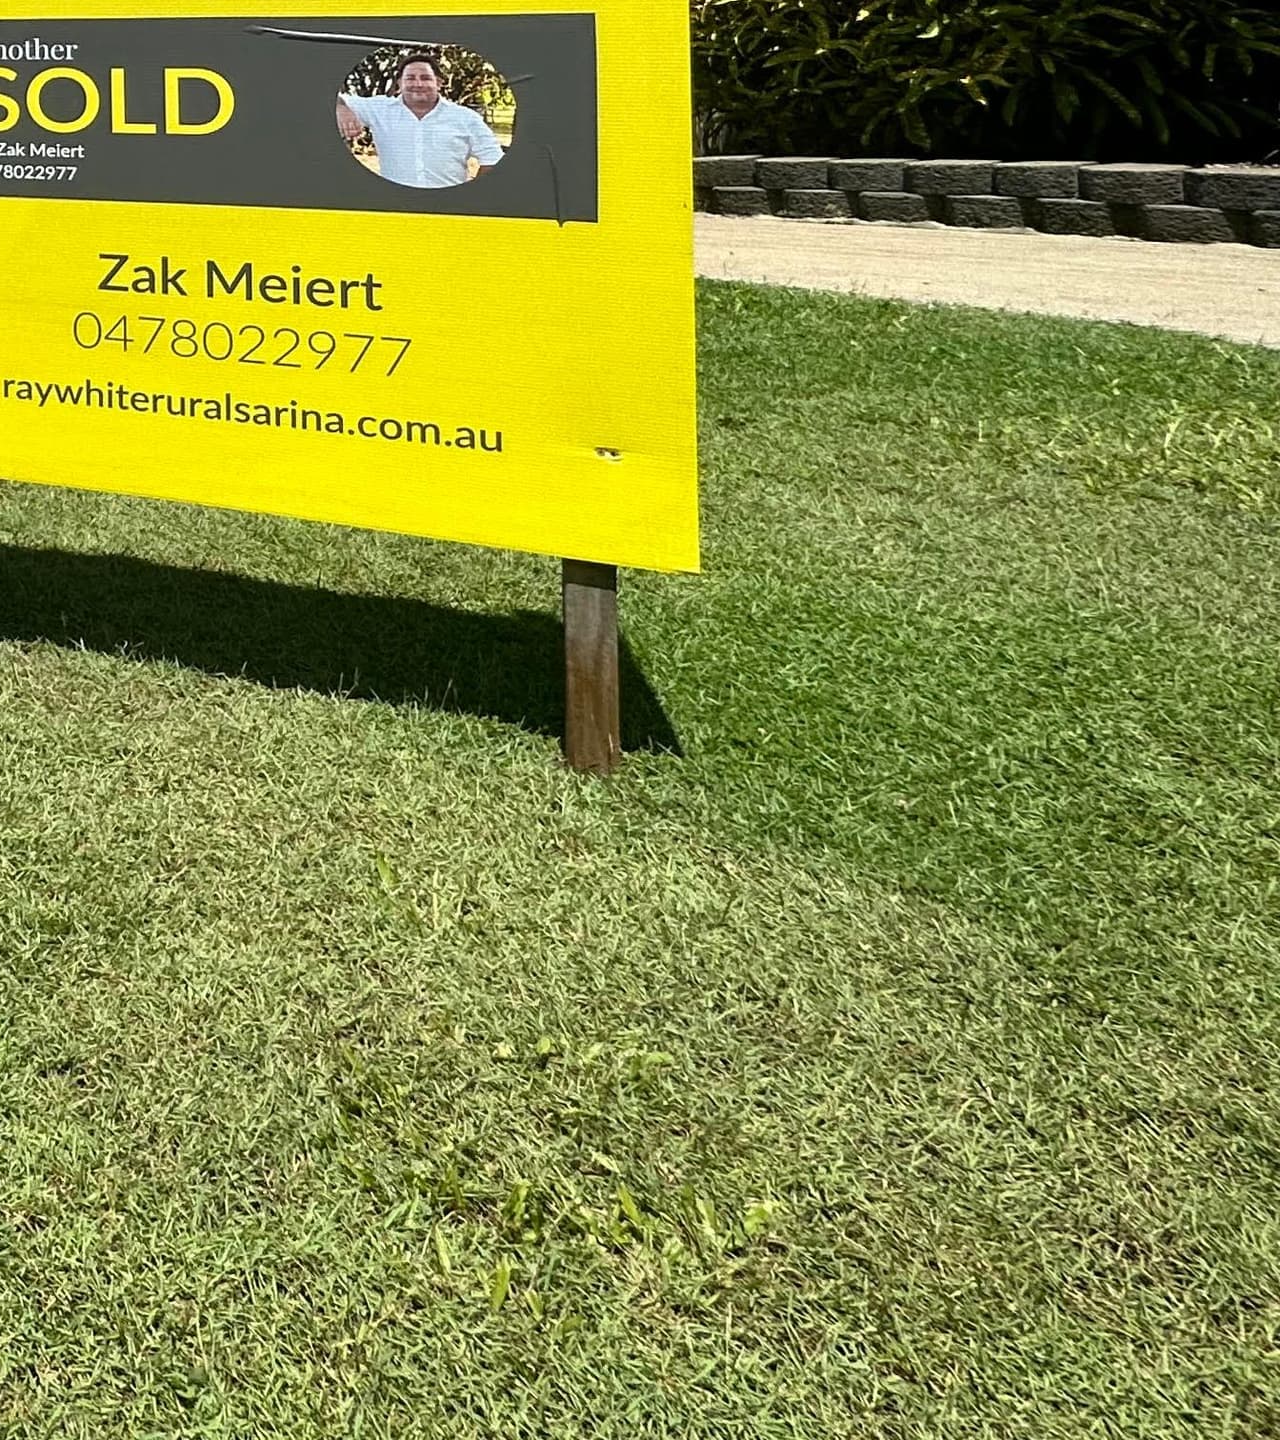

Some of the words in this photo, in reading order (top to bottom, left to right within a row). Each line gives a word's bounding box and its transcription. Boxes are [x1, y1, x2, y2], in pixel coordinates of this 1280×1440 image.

[29, 142, 85, 158] Meiert
[98, 253, 187, 297] Zak
[206, 260, 383, 310] Meiert
[73, 312, 411, 376] 0478022977
[3, 377, 503, 452] raywhiteruralsarina.com.au
